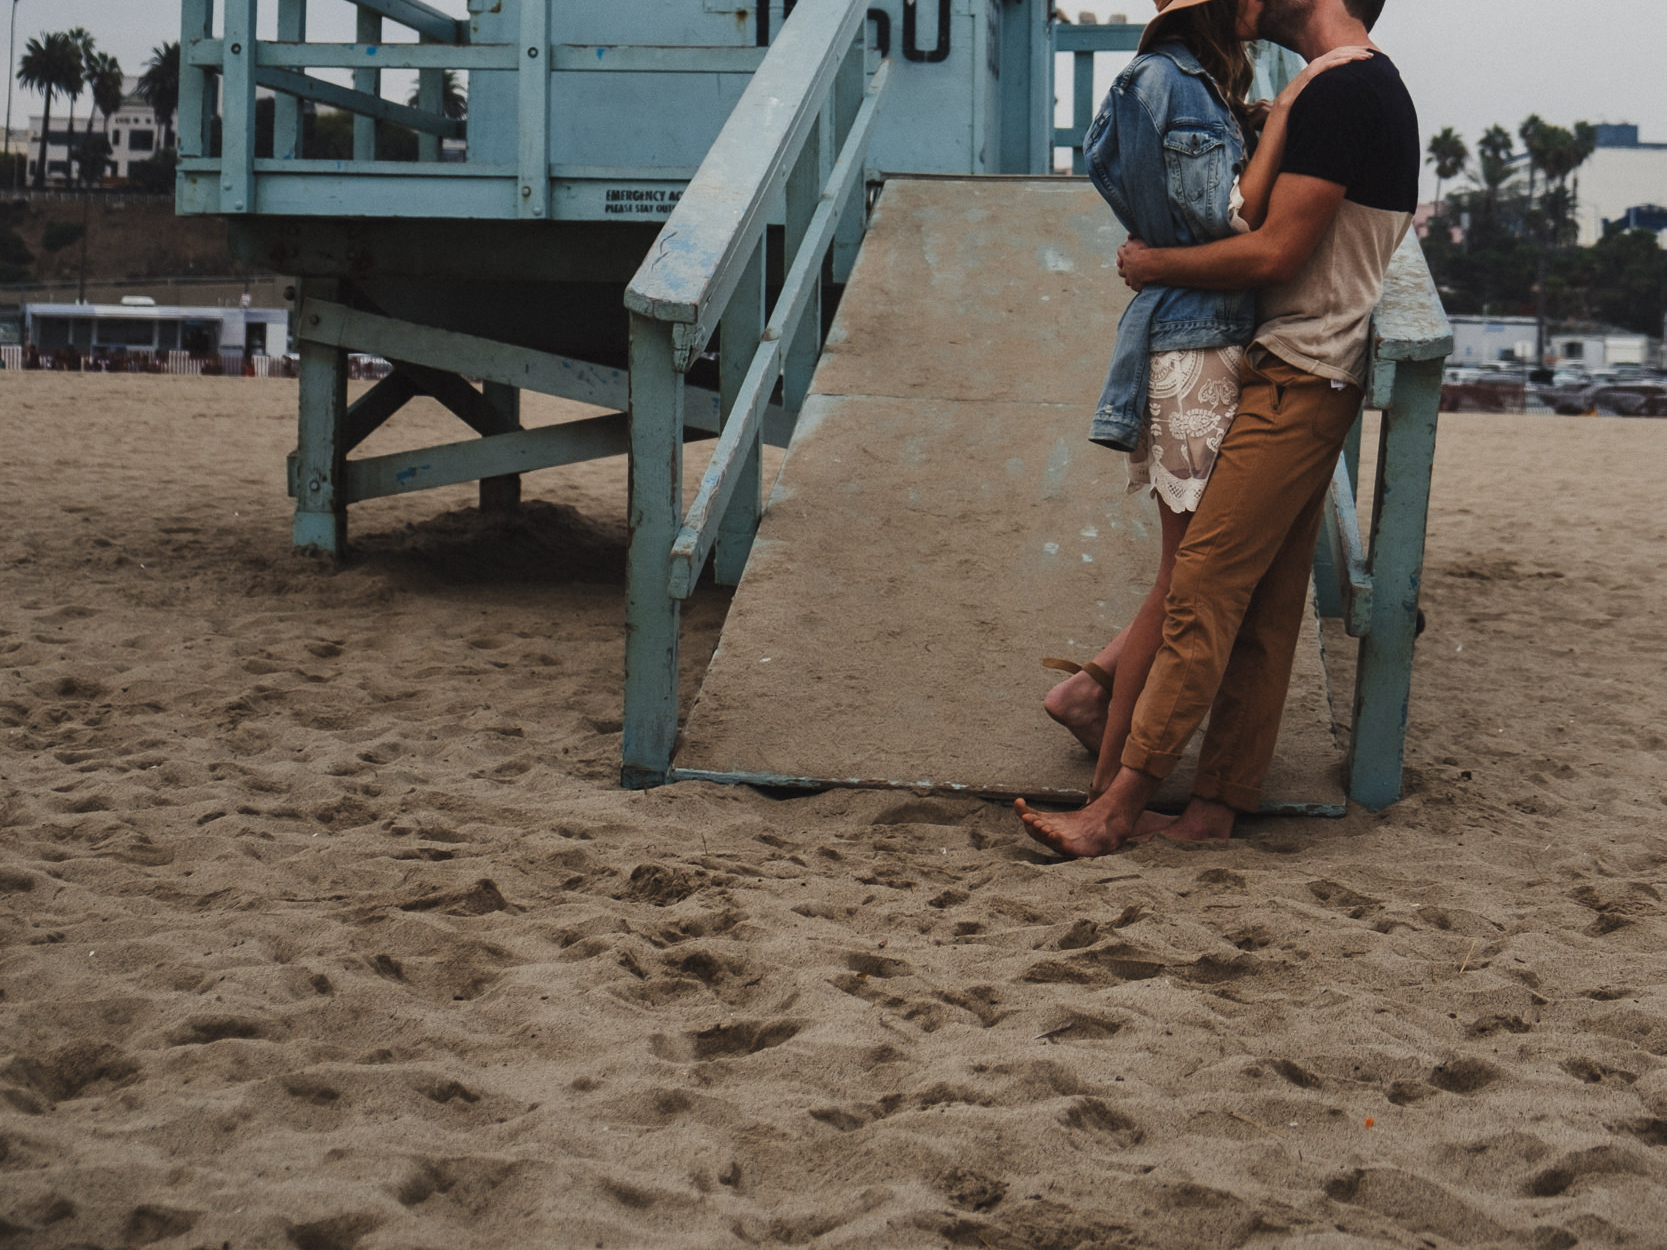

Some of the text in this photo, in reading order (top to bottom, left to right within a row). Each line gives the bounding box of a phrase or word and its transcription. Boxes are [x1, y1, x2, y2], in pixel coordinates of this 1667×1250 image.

[606, 190, 666, 202] EMERGENCY
[605, 204, 633, 214] PLEASE
[635, 204, 654, 214] STAY
